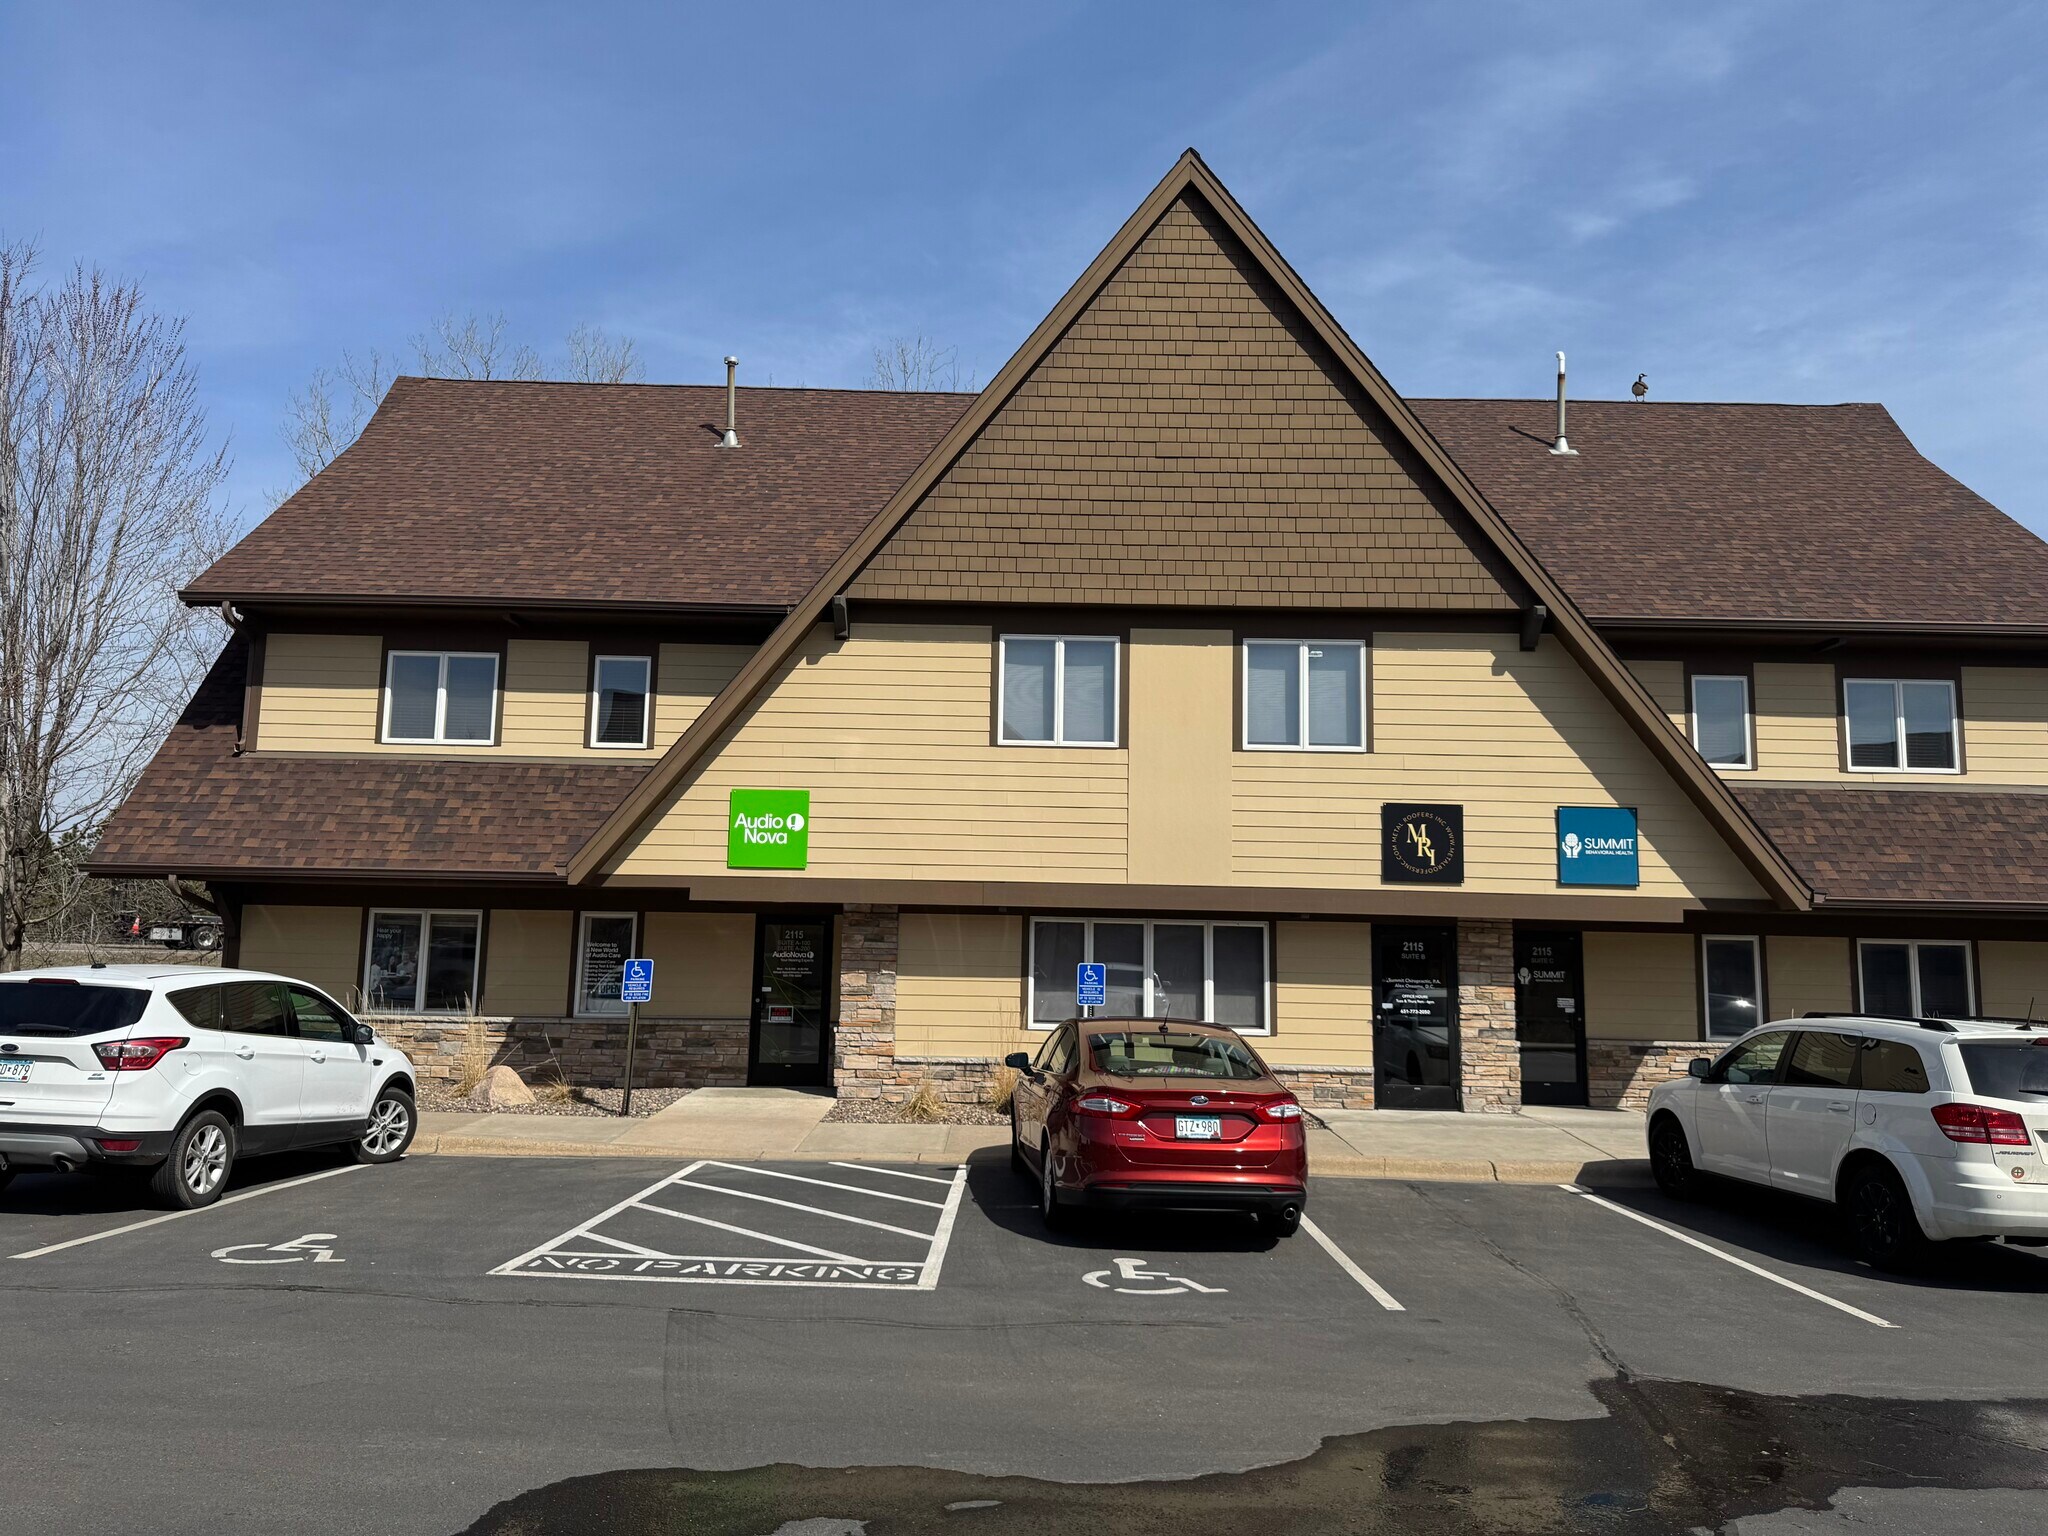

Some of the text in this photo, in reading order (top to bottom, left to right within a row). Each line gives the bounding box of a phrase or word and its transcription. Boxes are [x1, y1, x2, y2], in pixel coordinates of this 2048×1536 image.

[734, 813, 784, 829] Audio
[1392, 812, 1447, 843] METAL ROOFERS INC
[744, 829, 788, 845] Nova
[1584, 838, 1635, 850] SUMMIT
[785, 930, 804, 940] 2115
[1402, 941, 1424, 952] 2115
[1532, 946, 1553, 956] 2115
[1533, 970, 1566, 979] SUMMIT
[601, 985, 621, 994] OPEN
[12, 1064, 30, 1076] 879
[1178, 1120, 1219, 1133] GTZ 980
[528, 1256, 916, 1280] NO PARKING
